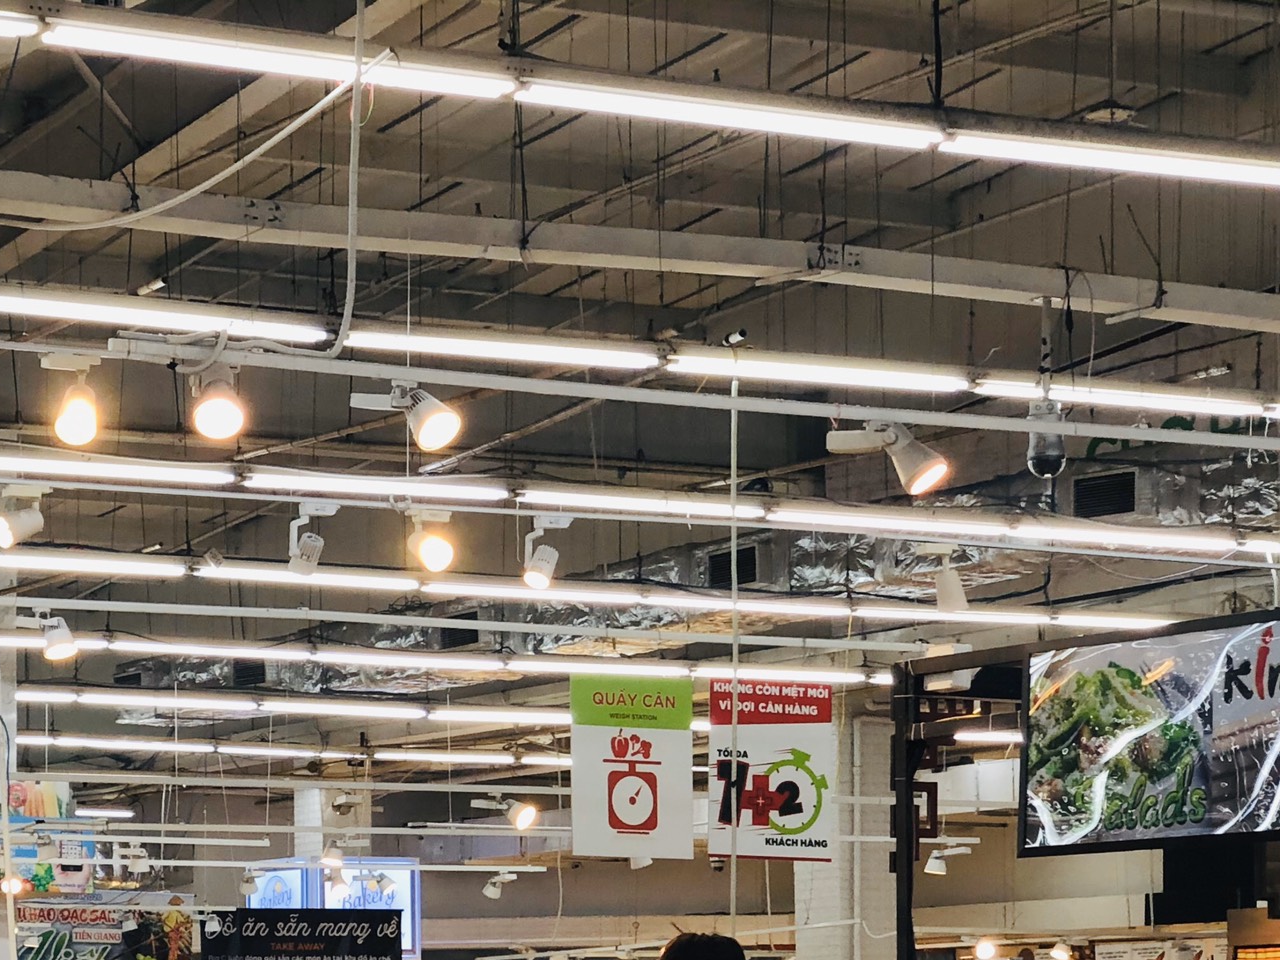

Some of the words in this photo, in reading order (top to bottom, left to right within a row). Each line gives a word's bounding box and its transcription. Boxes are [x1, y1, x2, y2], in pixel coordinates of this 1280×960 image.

[755, 682, 781, 696] CÒN
[643, 691, 676, 708] CÂN
[758, 700, 784, 714] CÂN
[785, 701, 818, 716] HÀNG
[765, 837, 797, 848] KHÁCH
[799, 837, 828, 848] HÀNG
[242, 918, 270, 937] ăn
[315, 922, 372, 945] mang
[297, 942, 326, 951] AWAY
